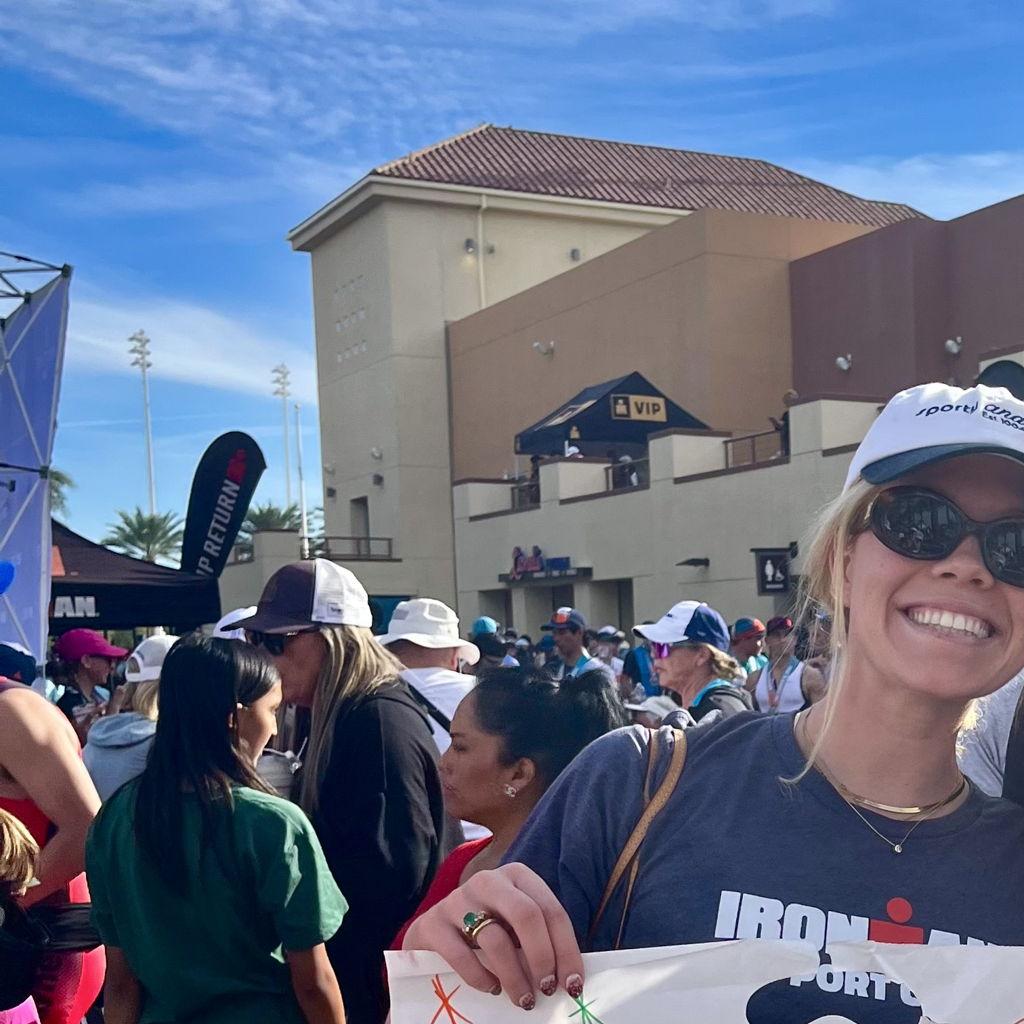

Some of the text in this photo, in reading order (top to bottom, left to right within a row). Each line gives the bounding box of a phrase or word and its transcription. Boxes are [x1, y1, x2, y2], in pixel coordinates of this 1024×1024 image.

[633, 400, 661, 415] VIP
[915, 401, 979, 417] sporty
[203, 479, 241, 557] RETURN
